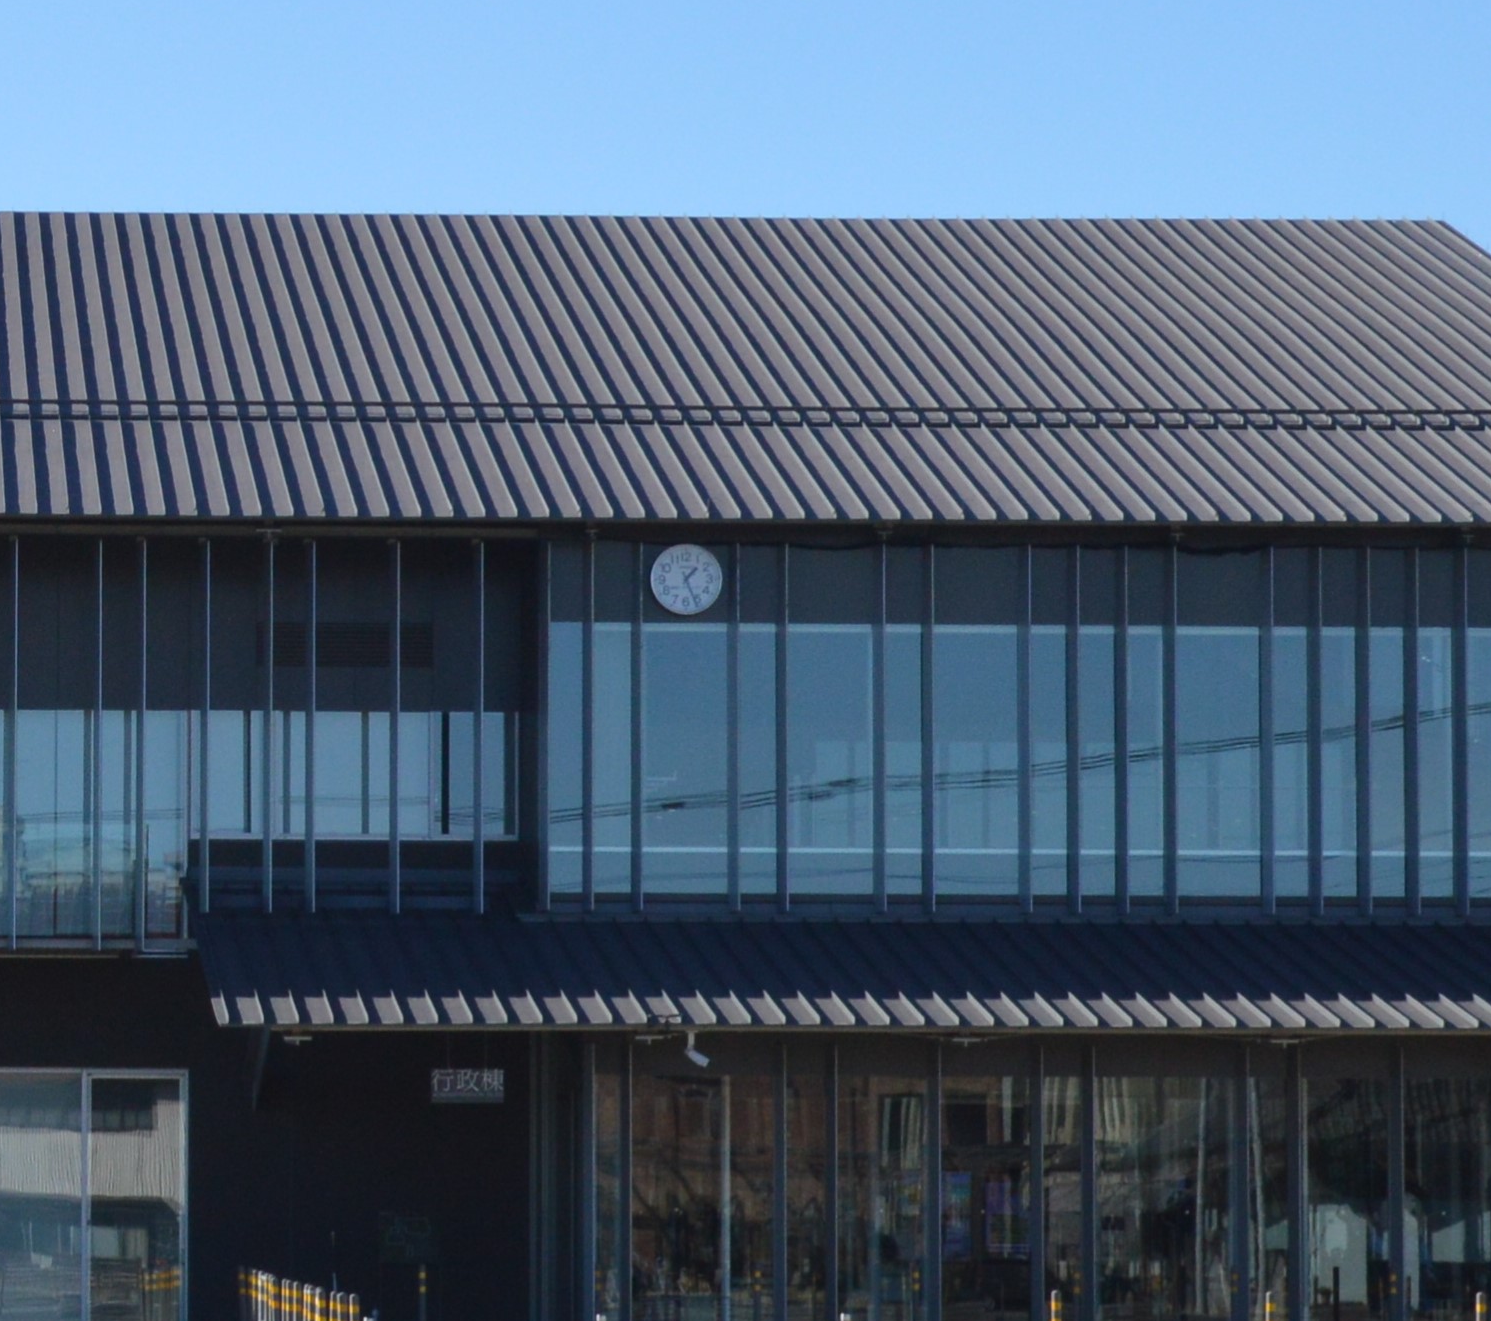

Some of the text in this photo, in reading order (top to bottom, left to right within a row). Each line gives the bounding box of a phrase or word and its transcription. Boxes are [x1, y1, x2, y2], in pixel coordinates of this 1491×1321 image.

[681, 552, 692, 563] 12
[658, 574, 666, 585] 9
[705, 574, 713, 584] 3
[663, 585, 670, 595] 8
[702, 585, 710, 594] 4
[682, 596, 690, 607] 6
[431, 1069, 504, 1091] 行政棟
